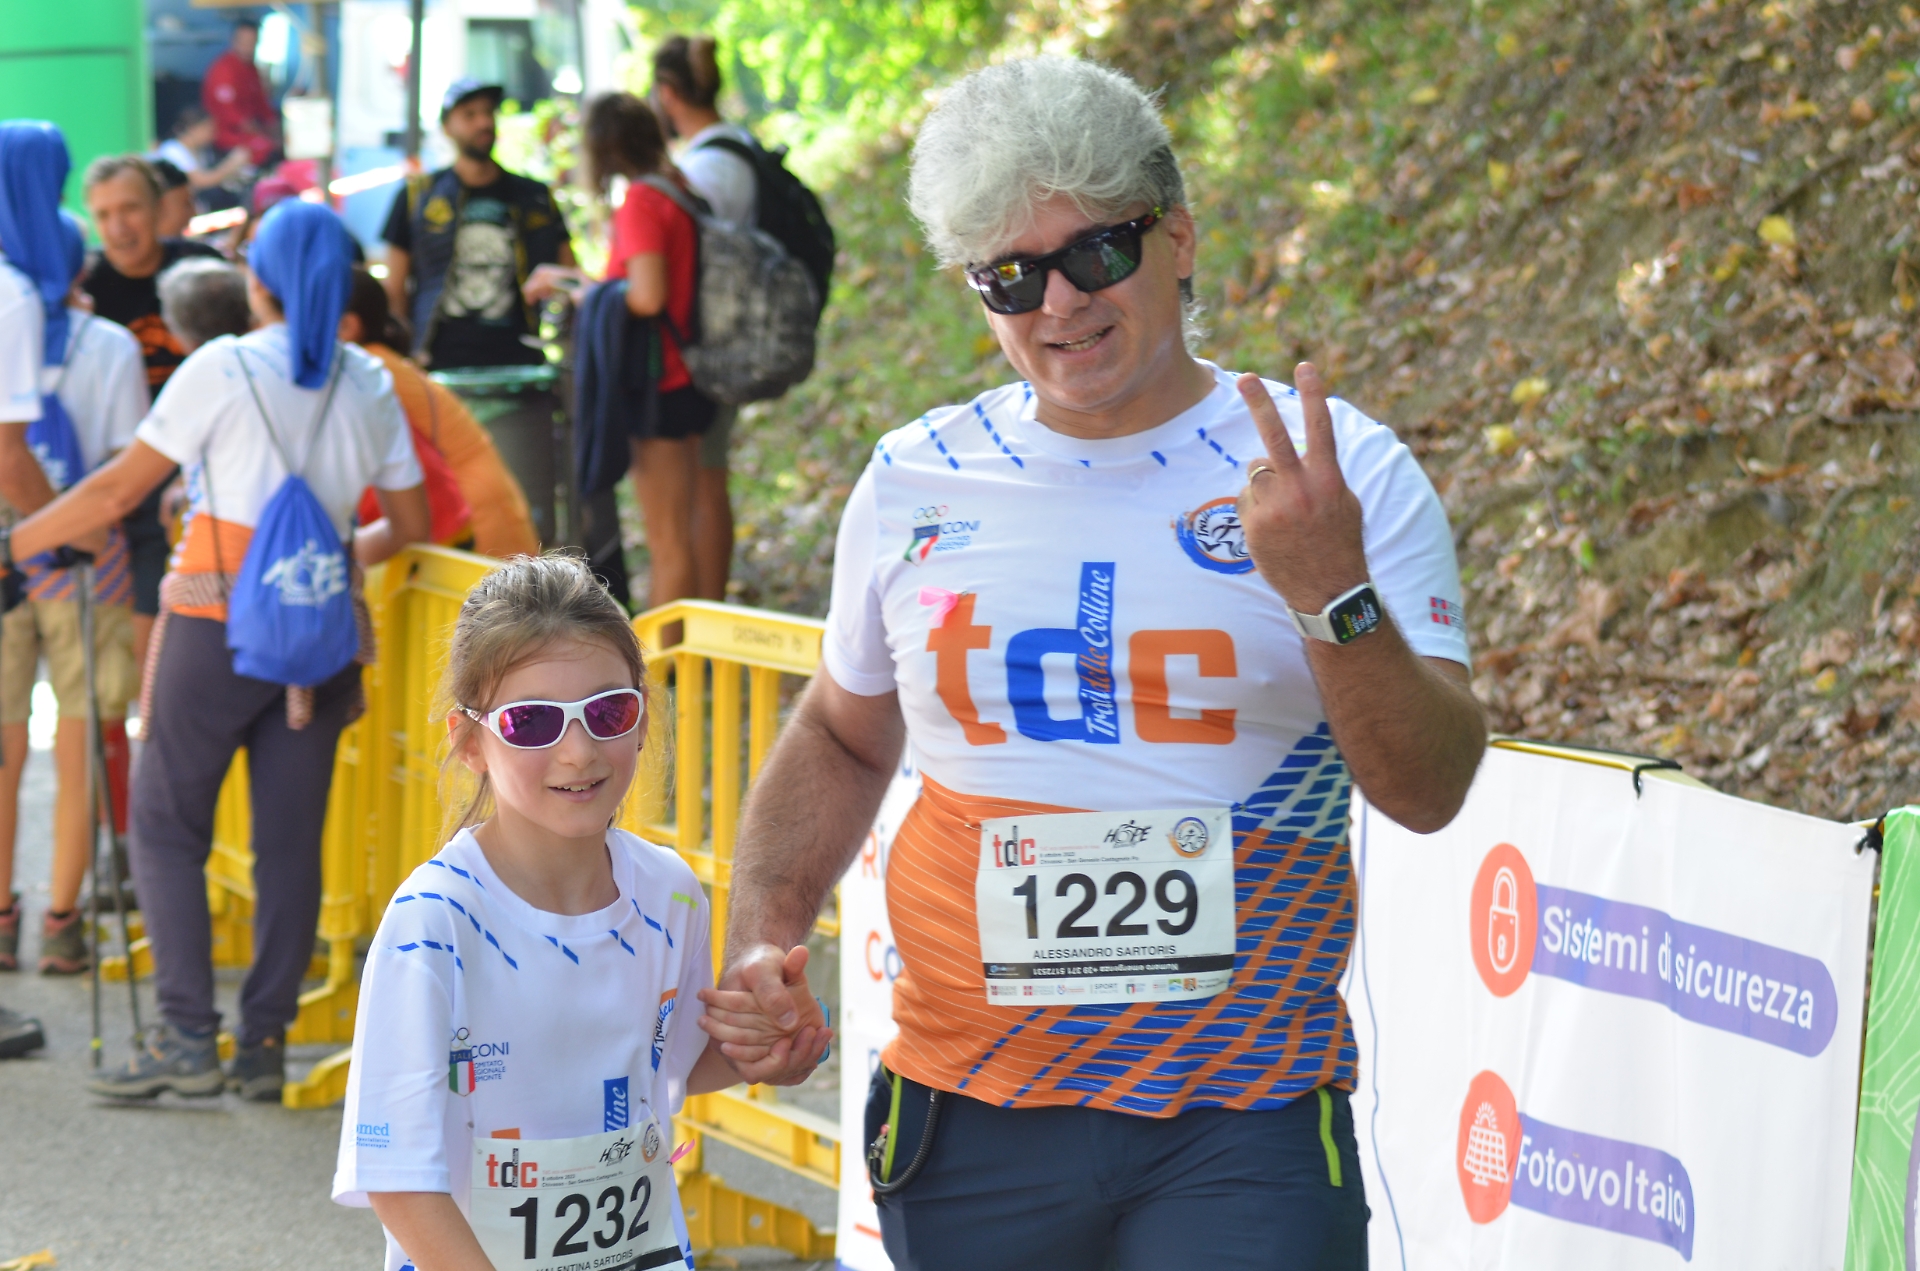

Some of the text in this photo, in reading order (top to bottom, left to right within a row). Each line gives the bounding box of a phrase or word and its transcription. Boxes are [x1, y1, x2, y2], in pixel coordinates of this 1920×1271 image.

[992, 825, 1036, 868] tdc
[1013, 869, 1198, 939] 1229
[1032, 945, 1177, 959] ALESSANDRO SARTORIS
[1542, 905, 1648, 975] Sistemi
[1675, 944, 1815, 1030] sicurezza
[471, 1041, 509, 1059] CONI
[474, 1060, 503, 1069] OMITATO
[474, 1066, 506, 1075] EGIONALE
[356, 1122, 390, 1136] med
[486, 1147, 538, 1188] tdc
[510, 1175, 651, 1260] 1232
[593, 1249, 633, 1269] SARTORIS
